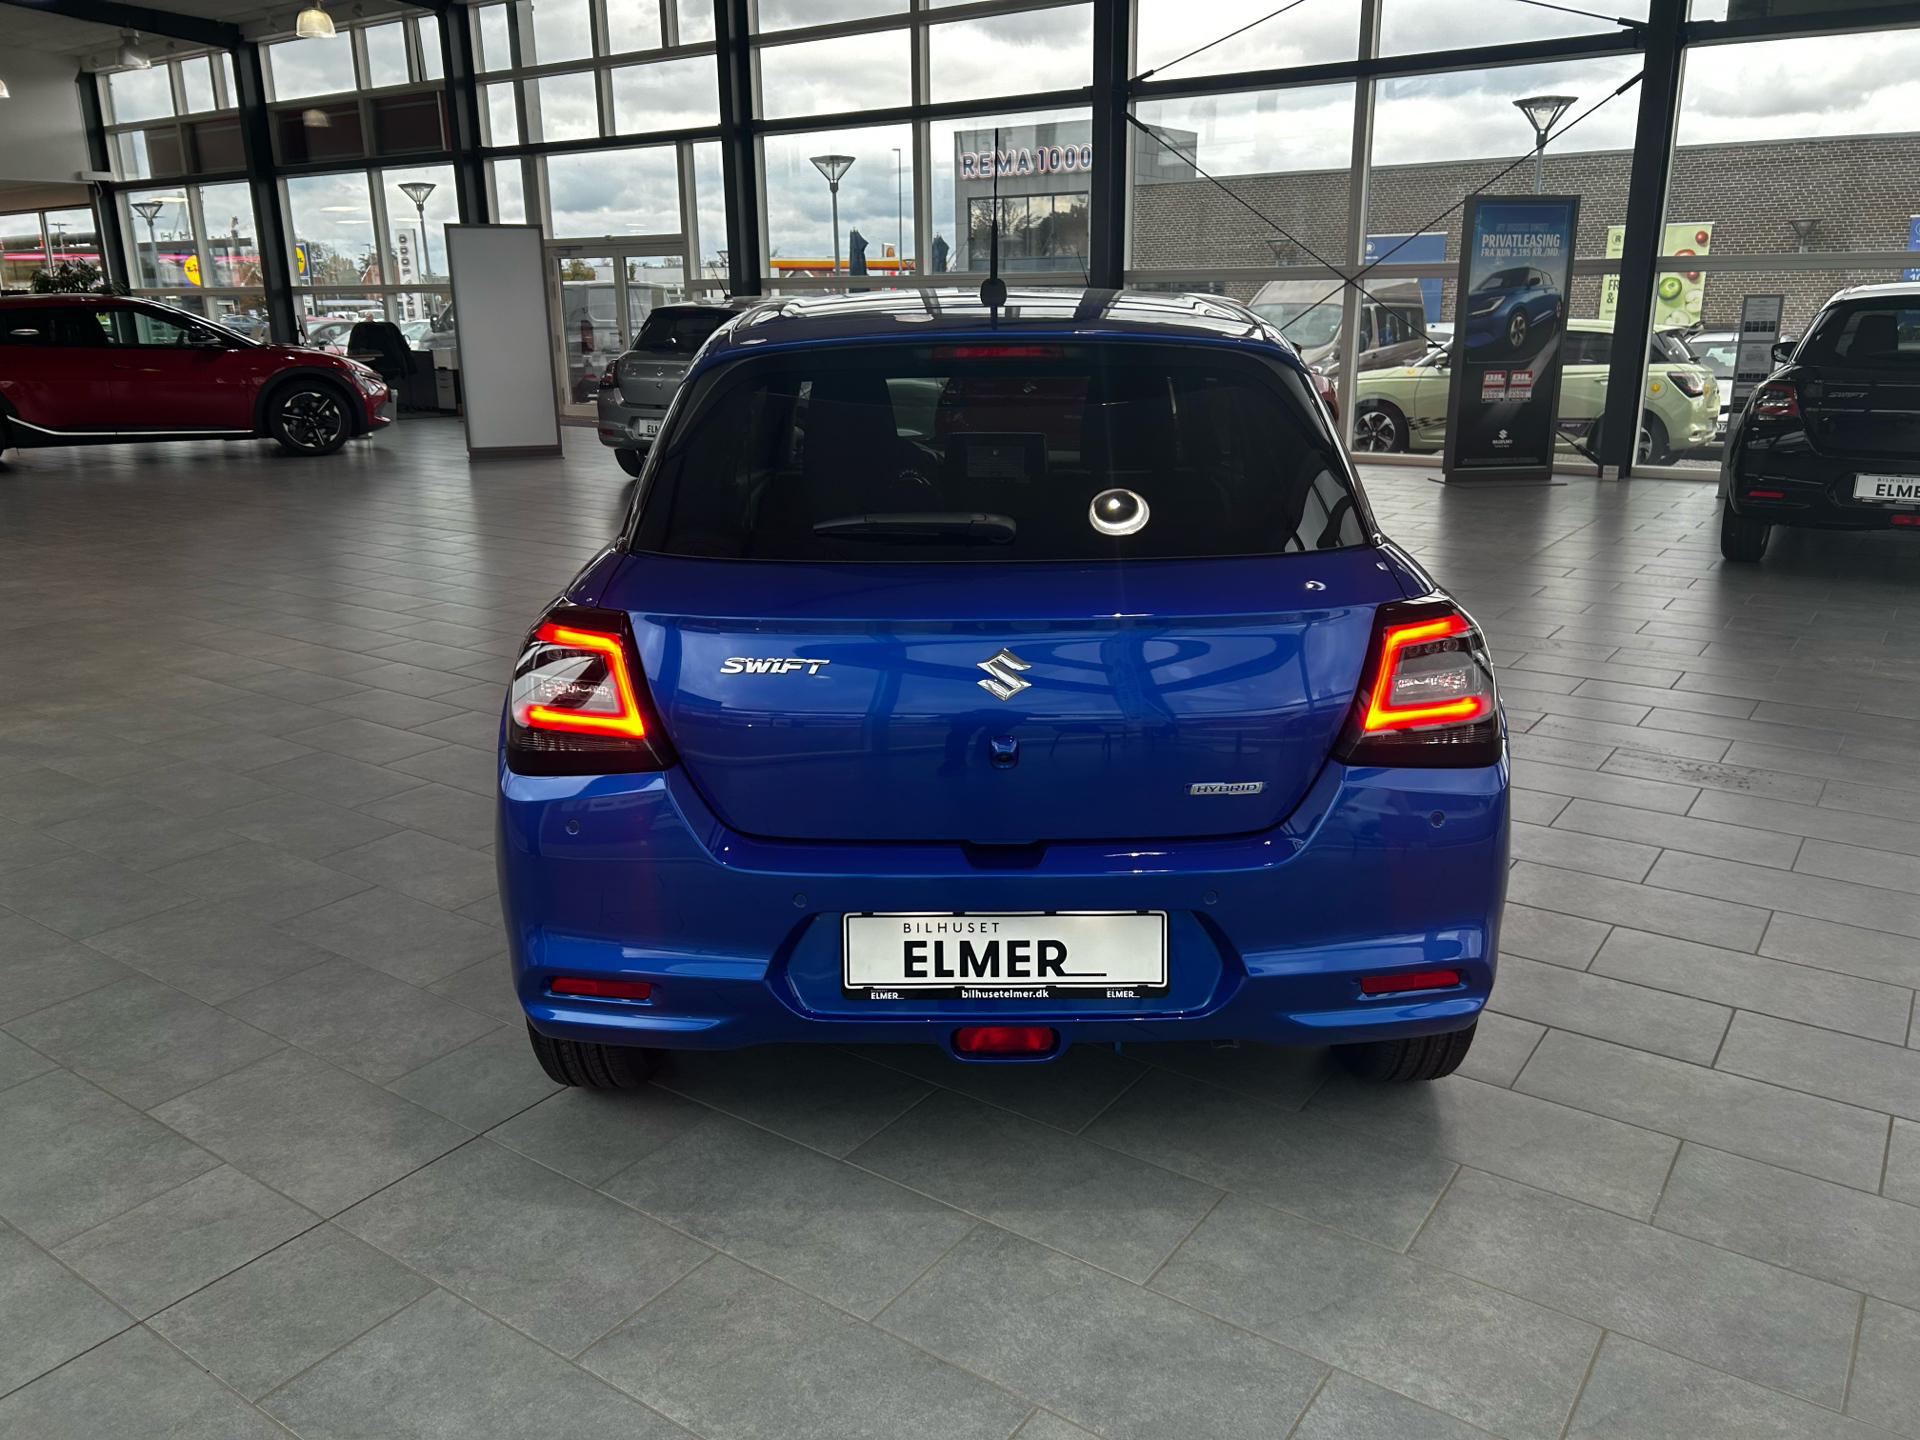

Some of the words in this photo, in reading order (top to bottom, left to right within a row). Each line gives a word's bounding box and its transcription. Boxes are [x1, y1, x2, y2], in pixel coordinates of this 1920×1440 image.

[961, 150, 1033, 177] REMA
[1036, 144, 1092, 173] 1000
[1482, 234, 1560, 247] PRIVATLEASING
[1481, 248, 1494, 257] FRA
[1496, 248, 1511, 257] KUN
[1512, 248, 1531, 257] 2.195
[1512, 373, 1532, 381] BIL
[1875, 483, 1920, 498] ELME
[720, 657, 830, 674] SWIFT
[1196, 784, 1258, 793] HYBRID
[903, 922, 1000, 934] BILHUSET
[904, 939, 1068, 978] ELMER
[961, 988, 1050, 999] bilhusetelmer.dk
[1106, 990, 1135, 998] ELMER
